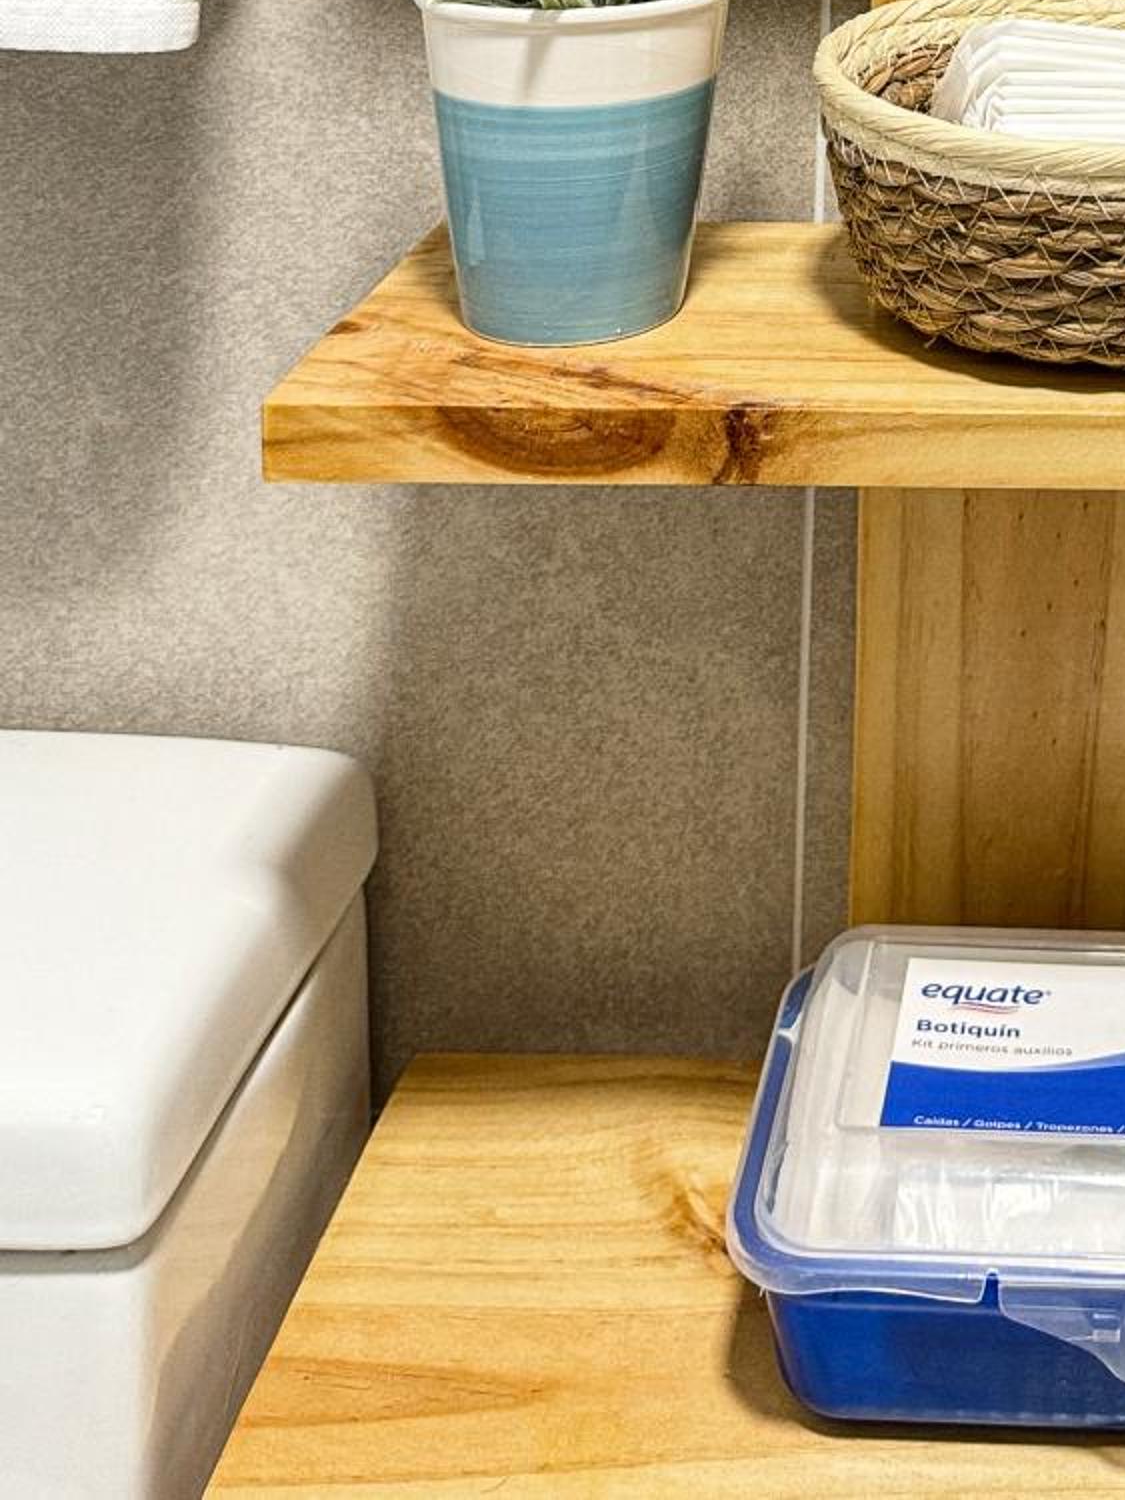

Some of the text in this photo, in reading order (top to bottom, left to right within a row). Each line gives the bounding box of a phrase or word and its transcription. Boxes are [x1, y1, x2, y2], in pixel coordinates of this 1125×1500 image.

[920, 982, 1045, 1006] equate
[911, 1039, 1073, 1057] Kit primeros auxilios
